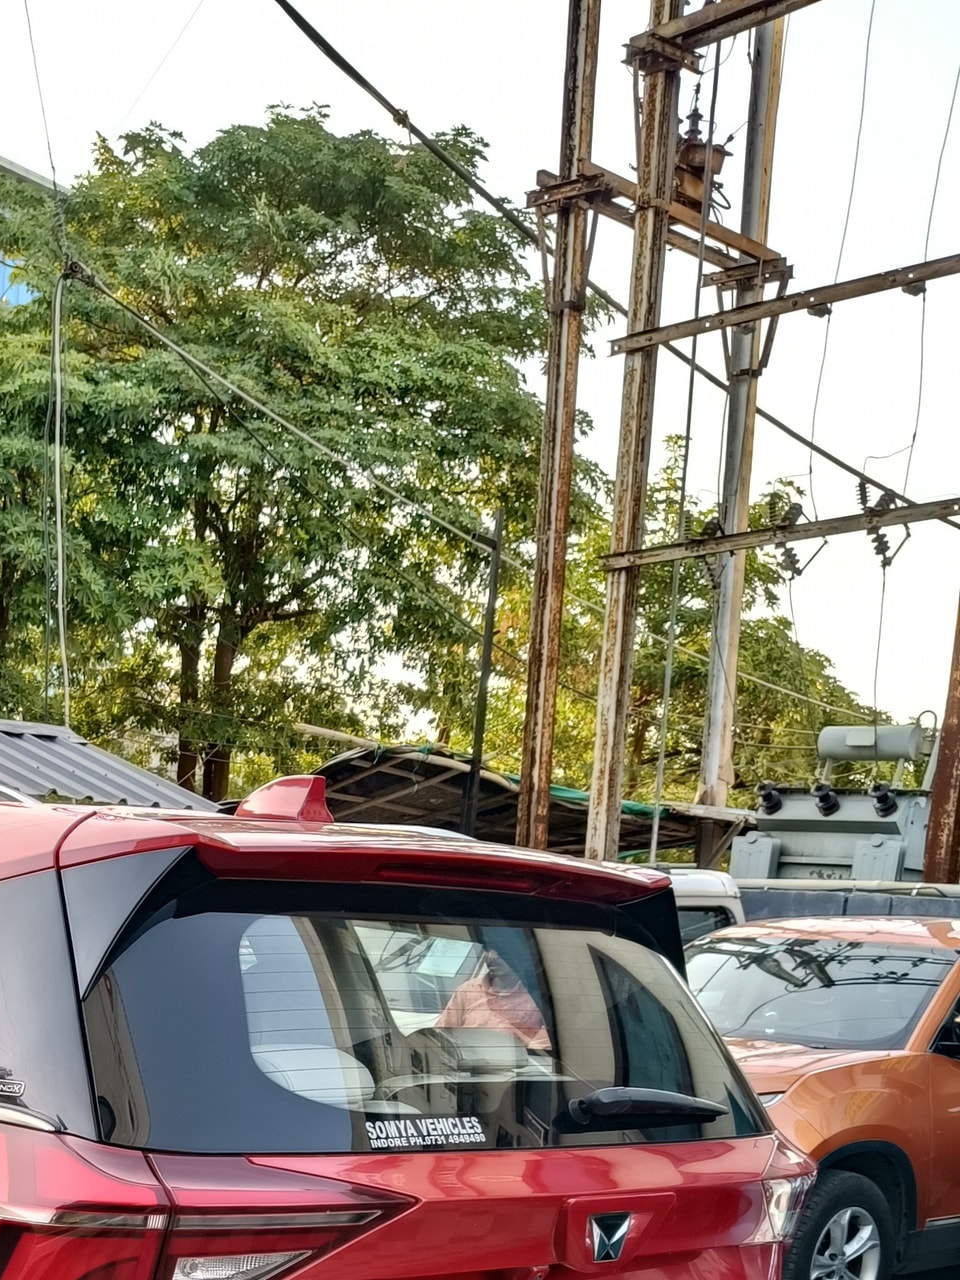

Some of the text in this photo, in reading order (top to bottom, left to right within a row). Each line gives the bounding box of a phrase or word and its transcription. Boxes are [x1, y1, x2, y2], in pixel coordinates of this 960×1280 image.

[365, 1116, 482, 1139] SOMYA VEHICLES
[370, 1133, 486, 1149] INDORE PH.0731 4949490
